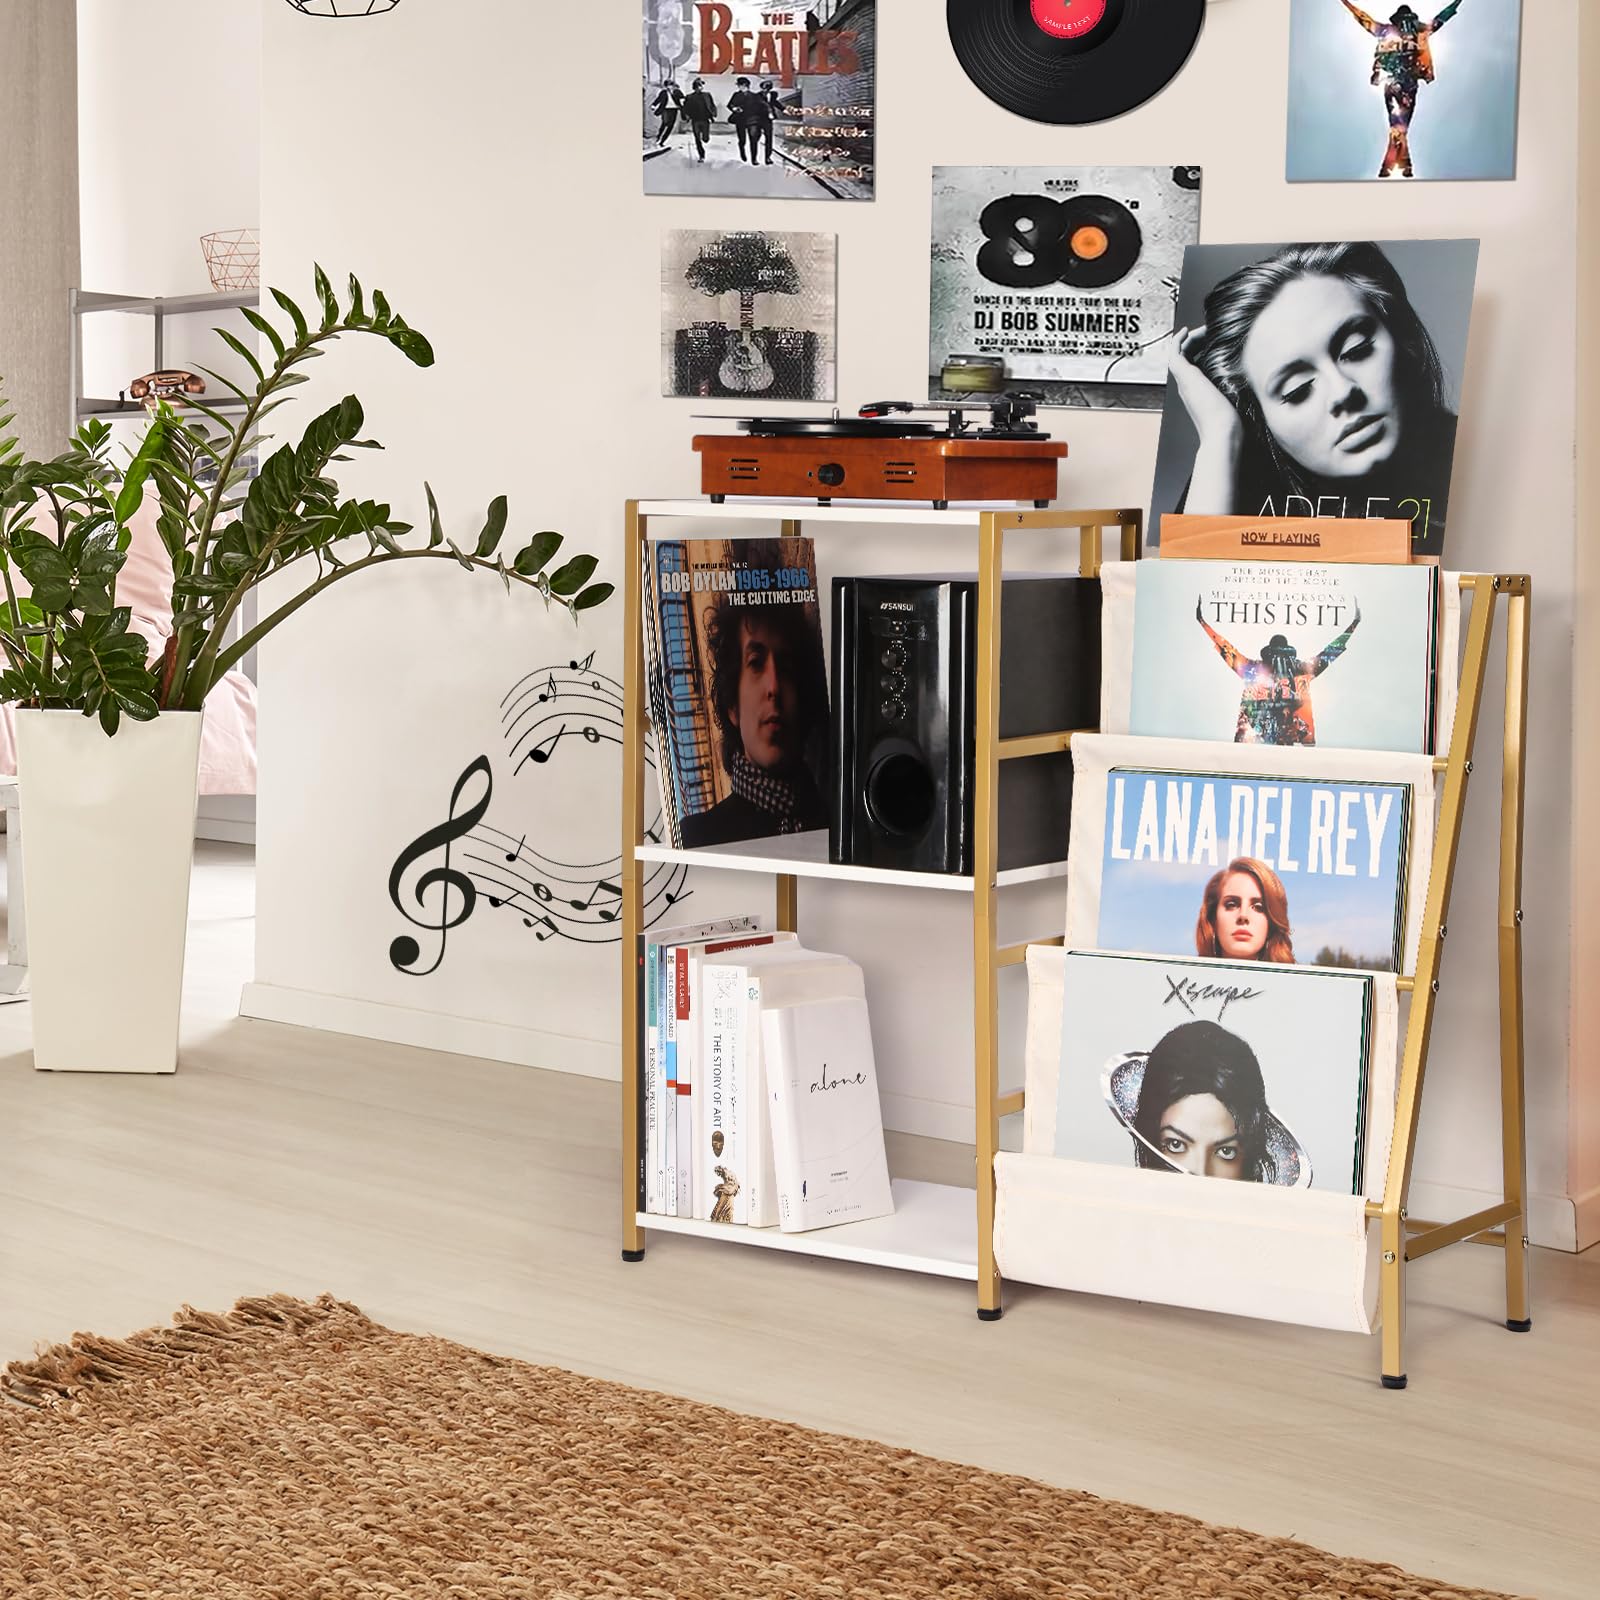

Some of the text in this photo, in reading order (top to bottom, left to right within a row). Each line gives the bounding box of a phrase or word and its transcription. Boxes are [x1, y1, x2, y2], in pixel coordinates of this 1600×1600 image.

[761, 13, 794, 26] THE
[1043, 15, 1091, 30] SAMPLE TEXT
[694, 3, 862, 89] BEATLES
[974, 311, 1141, 334] DJ BOB SUMMERS
[1397, 498, 1431, 539] 21
[1241, 532, 1321, 546] NOW PLAYING
[661, 568, 810, 593] BOB DYLAN 1965-1966
[1224, 576, 1271, 585] NSPIRED
[1232, 567, 1252, 576] THE
[727, 589, 816, 606] THE CUTTING EDGE
[888, 602, 914, 612] SANSUI
[1210, 602, 1347, 627] THIS IS IT
[1111, 777, 1393, 878] LANA DEL REY
[1162, 974, 1265, 1022] Xscape
[713, 1034, 722, 1054] THE
[713, 1056, 722, 1090] STORY
[810, 1063, 867, 1093] alone
[713, 1091, 722, 1106] OF
[713, 1107, 722, 1129] ART
